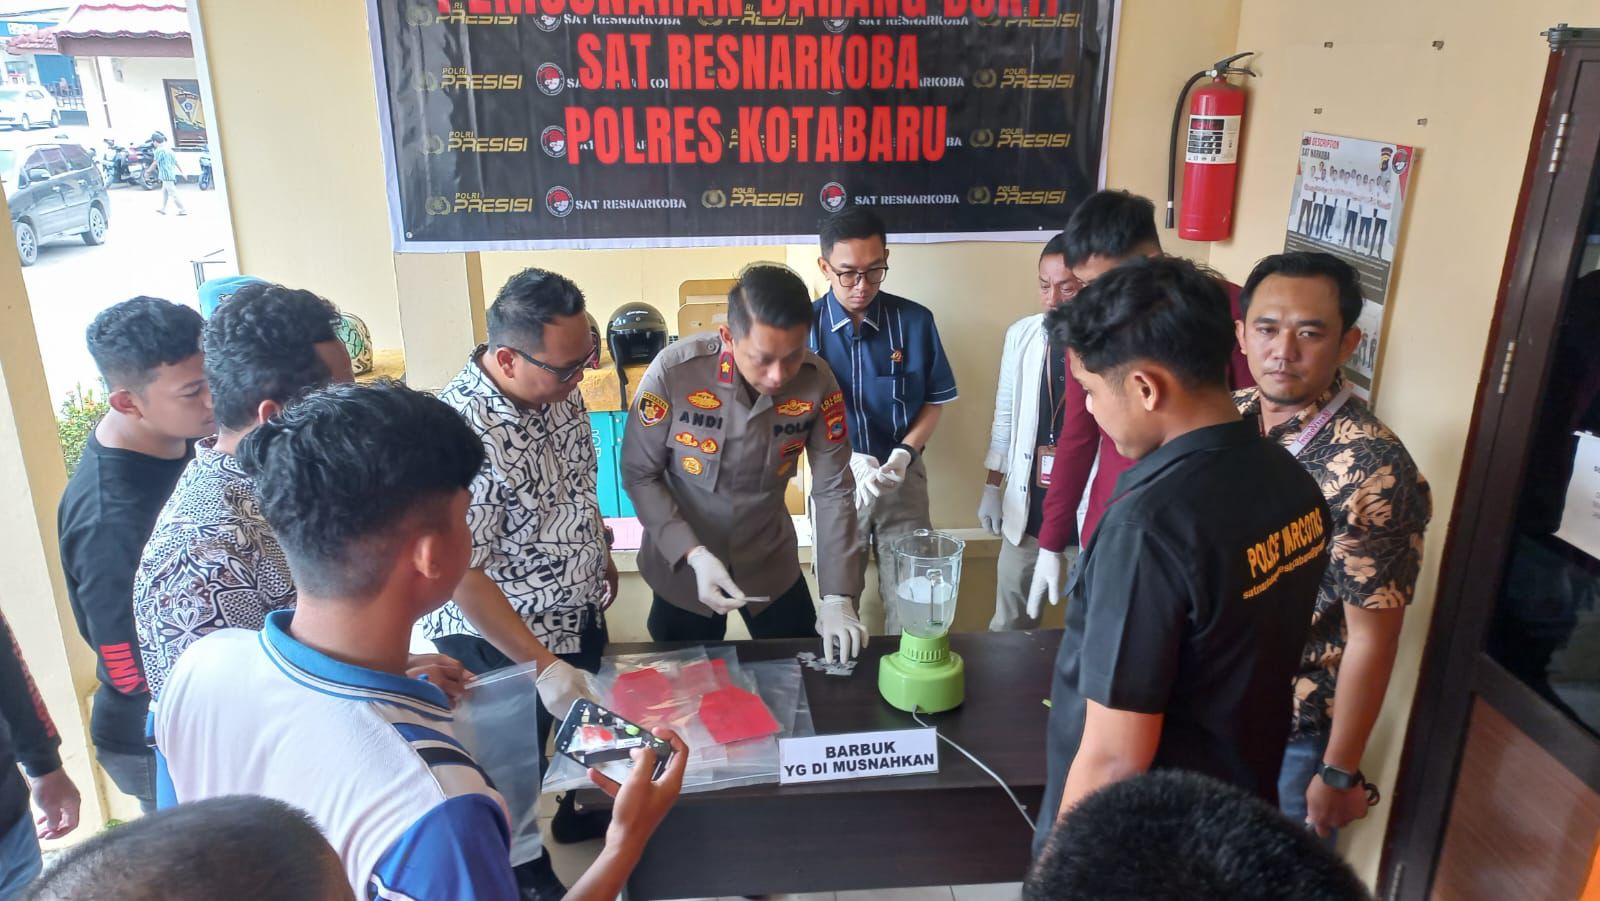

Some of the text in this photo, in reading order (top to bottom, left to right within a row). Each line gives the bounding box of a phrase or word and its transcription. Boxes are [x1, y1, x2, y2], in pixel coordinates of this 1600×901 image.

[577, 32, 652, 91] SAT
[667, 33, 919, 91] RESNARKOBA
[442, 67, 468, 75] POLRI
[441, 74, 523, 90] PRESISI
[1000, 74, 1076, 89] PRESISI
[448, 130, 474, 138] POLRI
[564, 105, 948, 165] POLRES KOTABARU
[997, 133, 1071, 148] PRESISI
[447, 137, 528, 152] PRESISI
[453, 198, 533, 213] PRESISI
[575, 198, 687, 210] SAT RESNARKOBA
[730, 193, 804, 207] PRESISI
[854, 194, 960, 206] SAT RESNARKOBA
[993, 191, 1067, 205] PRESISI
[679, 411, 723, 430] ANDI
[1246, 531, 1280, 579] POLICE
[825, 741, 896, 759] BARBUK
[784, 753, 935, 777] YG DI MUSNAHKAN
